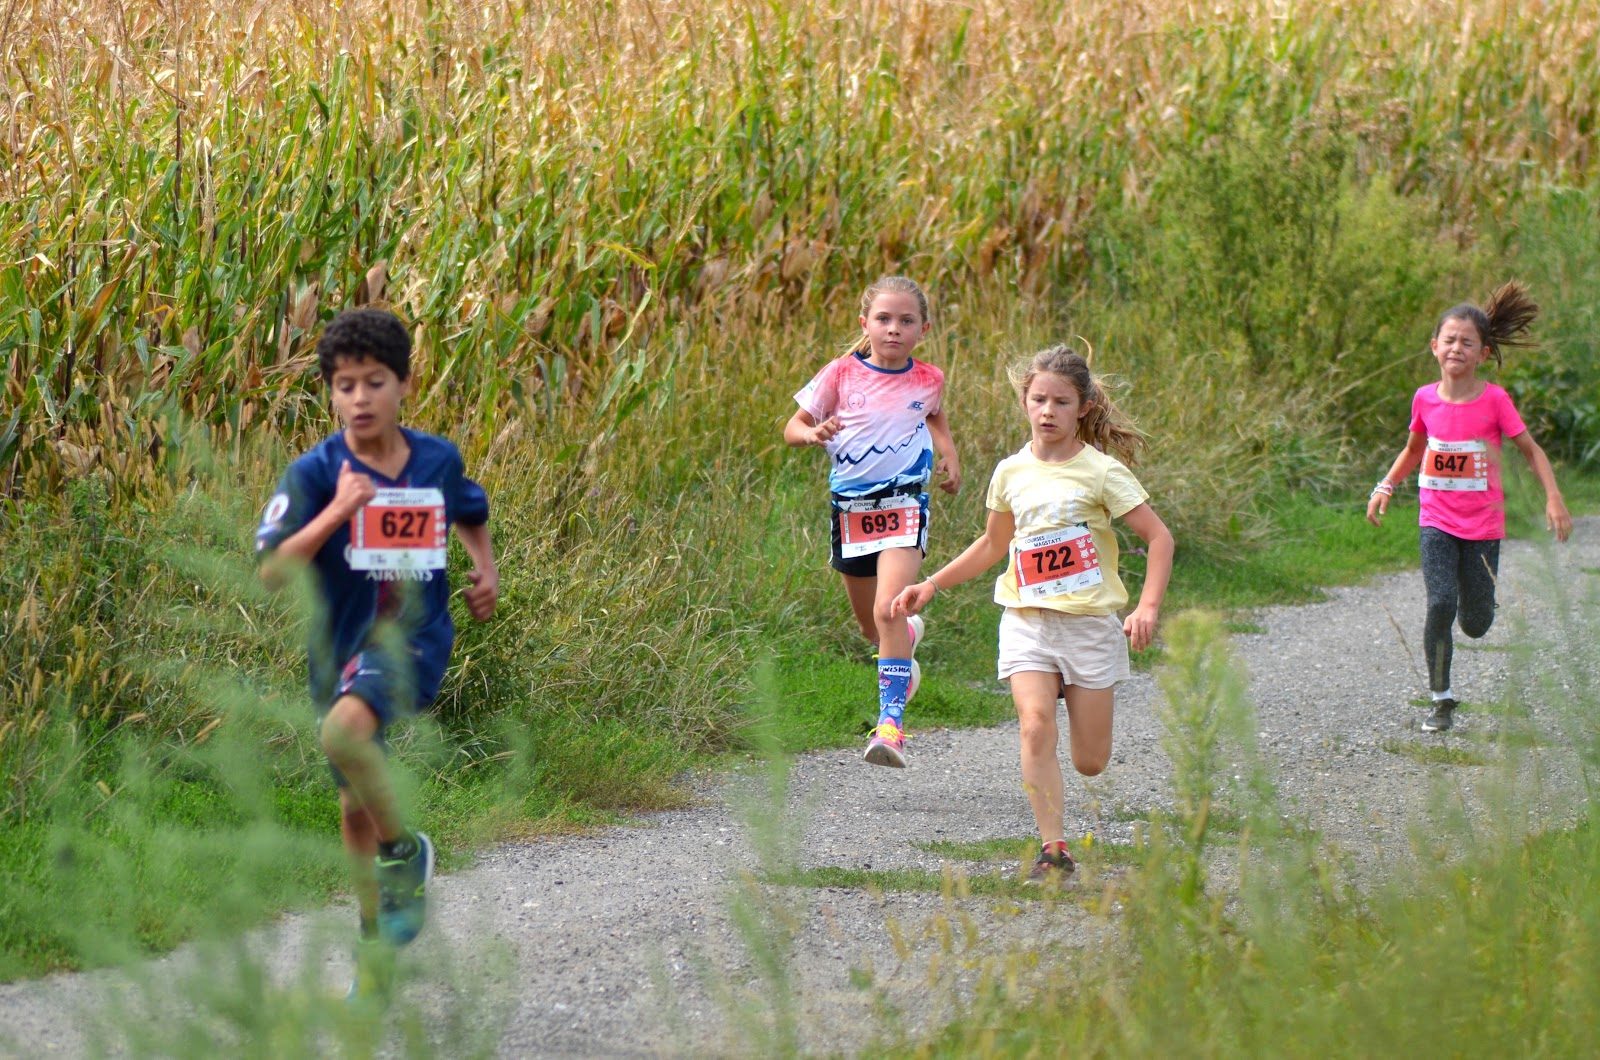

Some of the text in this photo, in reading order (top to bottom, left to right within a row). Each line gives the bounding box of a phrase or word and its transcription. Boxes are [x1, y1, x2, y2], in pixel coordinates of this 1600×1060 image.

[1434, 454, 1468, 472] 647
[381, 511, 430, 538] 627
[861, 512, 900, 535] 693
[1033, 536, 1062, 548] MAGSTATT
[1031, 545, 1075, 574] 722
